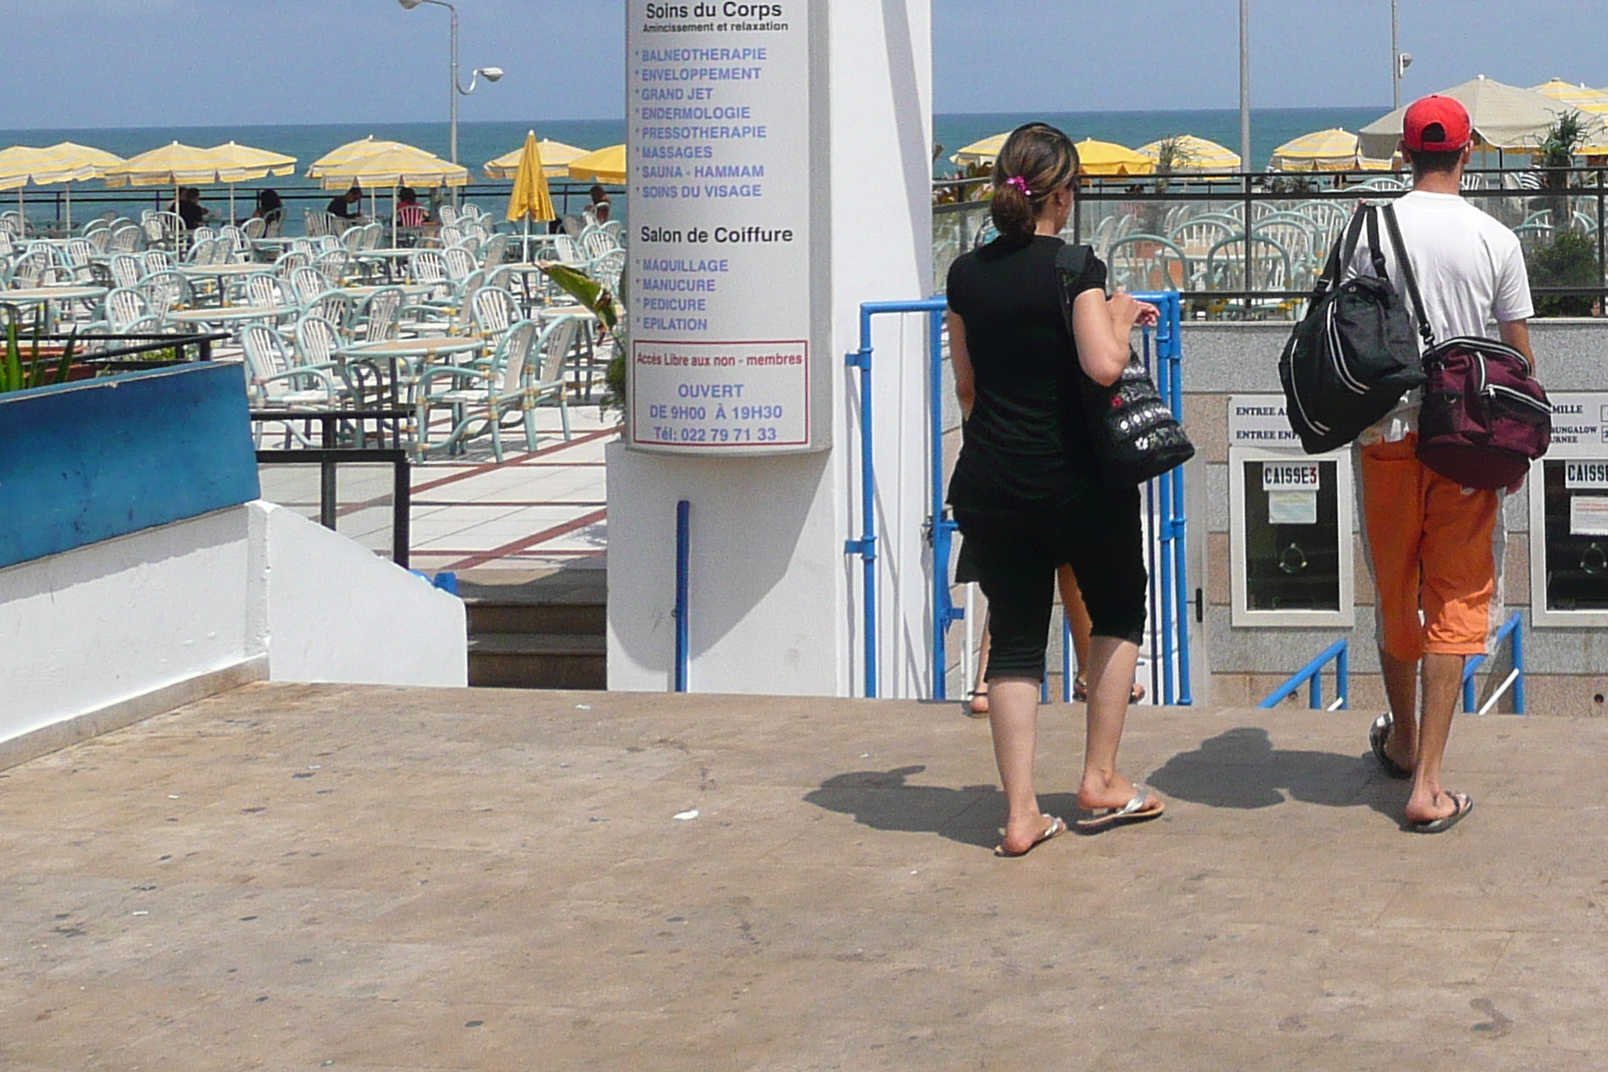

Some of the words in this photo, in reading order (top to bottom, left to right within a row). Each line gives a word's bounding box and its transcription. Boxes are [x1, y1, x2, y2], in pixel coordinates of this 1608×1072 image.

[646, 3, 688, 19] Soins
[694, 2, 716, 17] du
[723, 1, 782, 20] Corps
[643, 22, 714, 33] Amincissement
[717, 22, 727, 32] et
[730, 21, 789, 32] relaxation
[642, 48, 767, 62] BALNEOTHERAPIE
[642, 67, 762, 82] ENVELOPPEMENT
[642, 88, 684, 101] GRAND
[687, 87, 713, 100] JET
[642, 106, 750, 120] ENDERMOLOGIE
[642, 125, 767, 139] PRESSOTHERAPIE
[642, 146, 713, 159] MASSAGES
[642, 166, 683, 178] SAUNA
[694, 165, 765, 178] HAMMAM
[642, 185, 677, 199] SOINS
[682, 185, 700, 198] DU
[704, 184, 762, 197] VISAGE
[641, 227, 682, 243] Salon
[687, 227, 708, 243] de
[714, 226, 793, 243] Coiffure
[643, 259, 729, 273] MAQUILLAGE
[643, 279, 716, 292] MANUCURE
[643, 298, 706, 312] PEDICURE
[643, 317, 707, 331] EPILATION
[637, 352, 662, 366] Accès
[664, 353, 689, 366] Libre
[691, 355, 711, 366] aux
[714, 356, 736, 367] non
[746, 353, 803, 366] membres
[678, 383, 745, 398] OUVERT
[650, 405, 667, 418] DE
[671, 406, 706, 420] 9H00
[715, 403, 726, 420] À
[732, 405, 783, 419] 19H30
[1236, 407, 1275, 416] ENTREE
[1278, 407, 1287, 416] A
[1551, 404, 1583, 414] MILLE
[653, 426, 677, 441] Tél:
[681, 428, 706, 441] 022
[711, 428, 728, 441] 79
[734, 428, 750, 441] 71
[757, 427, 777, 441] 33
[1236, 431, 1276, 440] ENTREE
[1278, 431, 1300, 440] ENF
